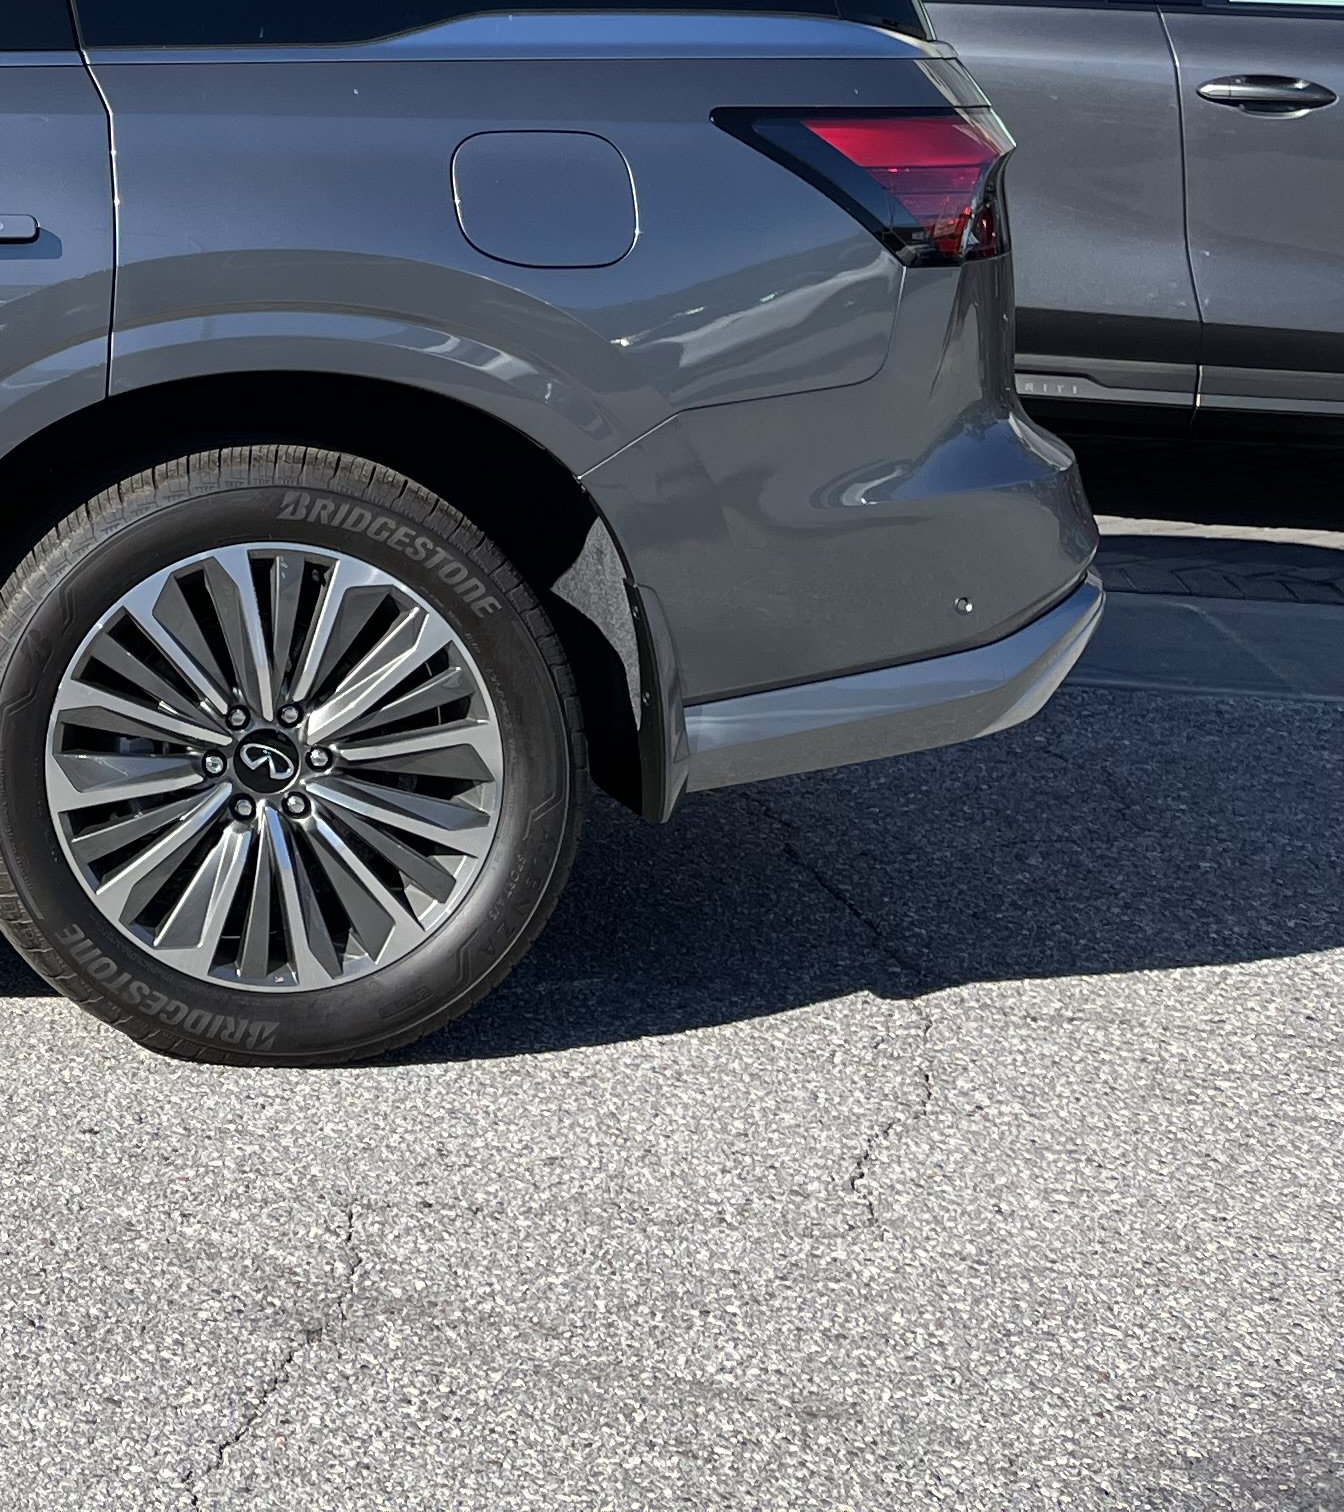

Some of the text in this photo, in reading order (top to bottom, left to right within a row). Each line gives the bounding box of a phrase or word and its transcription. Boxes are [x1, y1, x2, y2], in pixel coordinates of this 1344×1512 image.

[1024, 382, 1077, 395] NITI
[276, 490, 504, 621] BRIDGESTONE
[52, 923, 281, 1053] BRIDGESTONE
